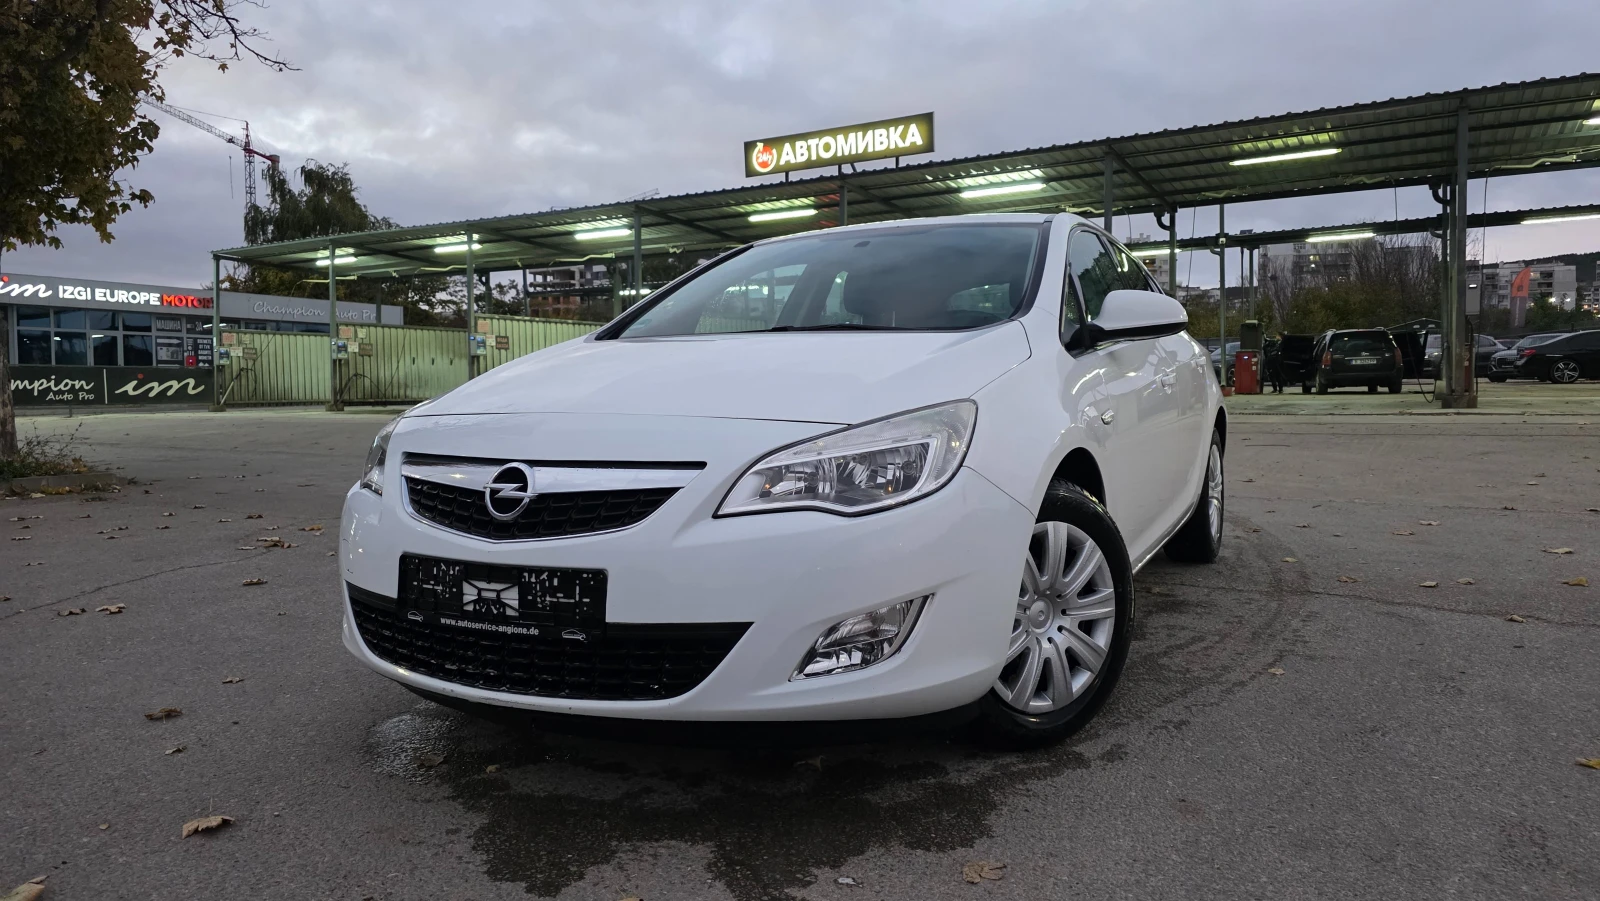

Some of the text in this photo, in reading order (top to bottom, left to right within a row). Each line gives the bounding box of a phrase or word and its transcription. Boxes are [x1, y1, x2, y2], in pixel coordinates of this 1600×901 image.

[779, 123, 923, 165] АВТОМИВКА
[58, 285, 91, 300] IZGI
[95, 288, 160, 305] EUROPE
[162, 294, 214, 309] MOTOR
[362, 309, 377, 321] Pr
[10, 375, 94, 396] mpion
[46, 391, 95, 401] Auto Pro
[115, 373, 205, 398] im
[440, 617, 539, 635] www.autoservice-angione.de
